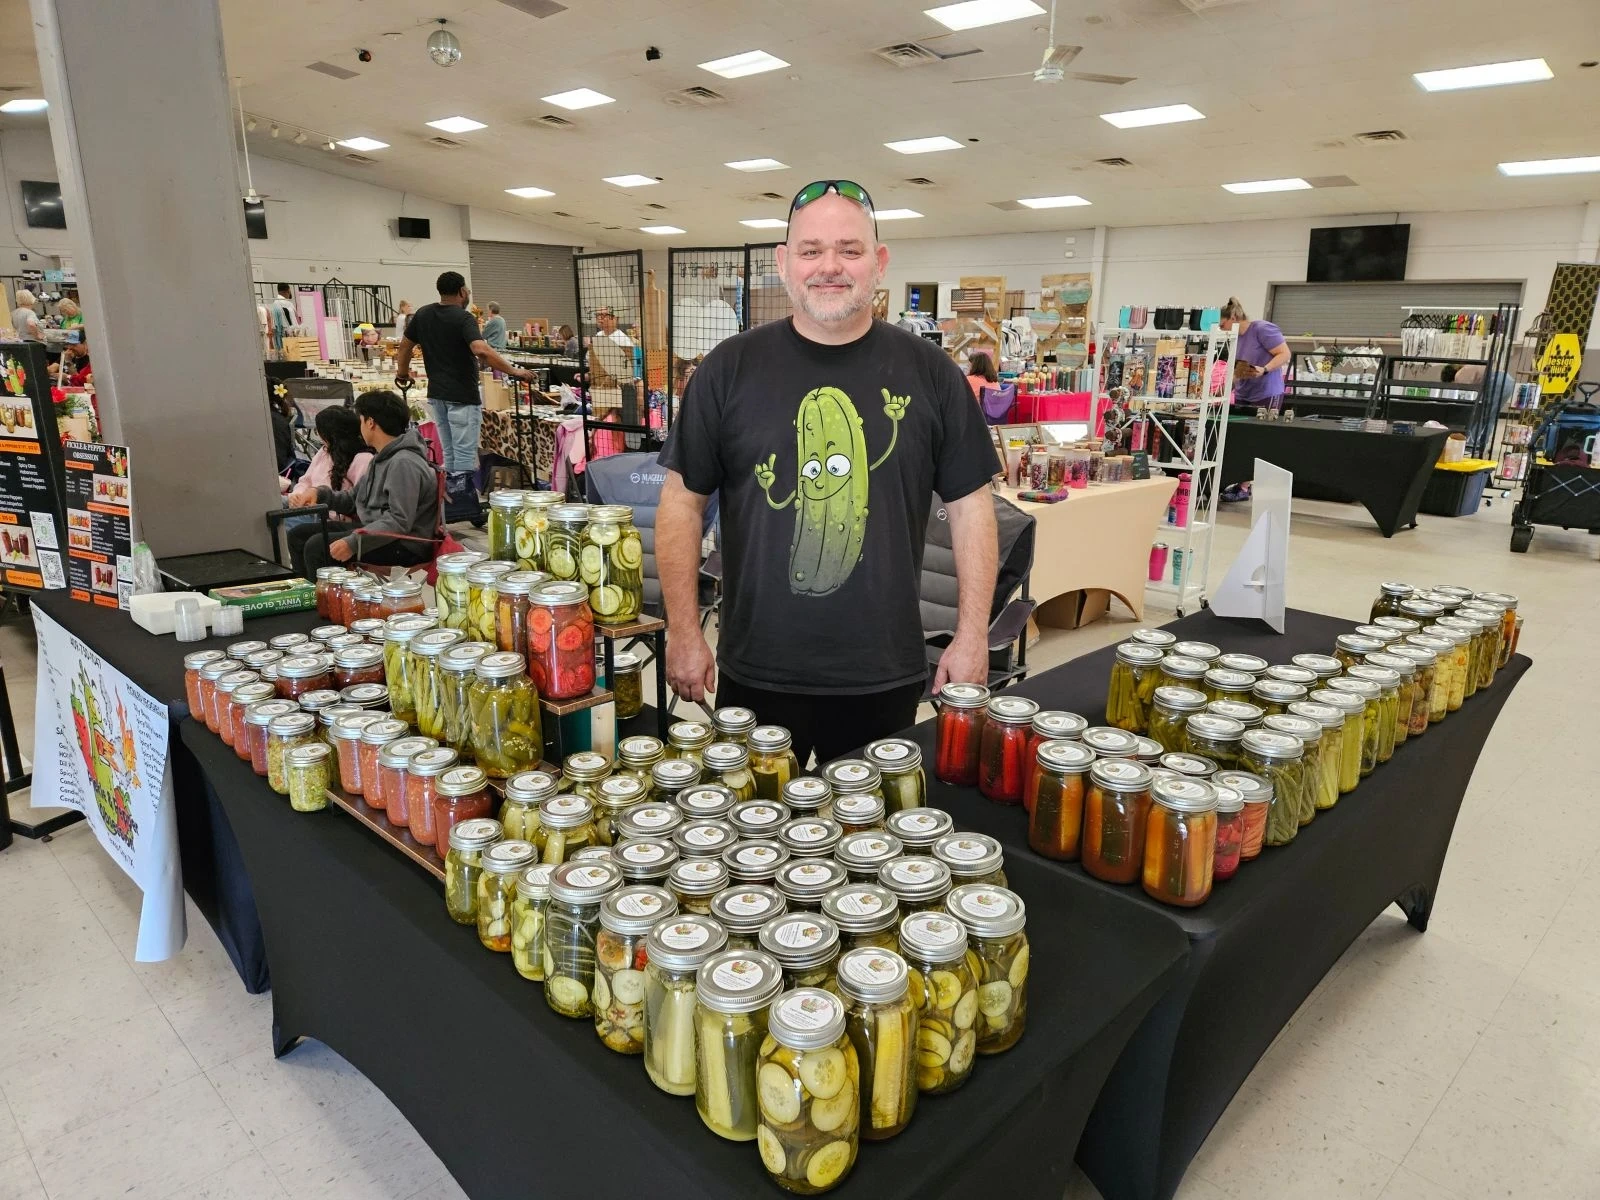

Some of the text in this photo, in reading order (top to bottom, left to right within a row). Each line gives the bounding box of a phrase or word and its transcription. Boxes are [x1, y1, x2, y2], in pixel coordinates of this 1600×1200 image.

[67, 441, 83, 449] PICKLE
[88, 444, 106, 453] PEPPER
[73, 452, 99, 461] OBSESSION
[240, 598, 301, 612] VINYL GLOVES
